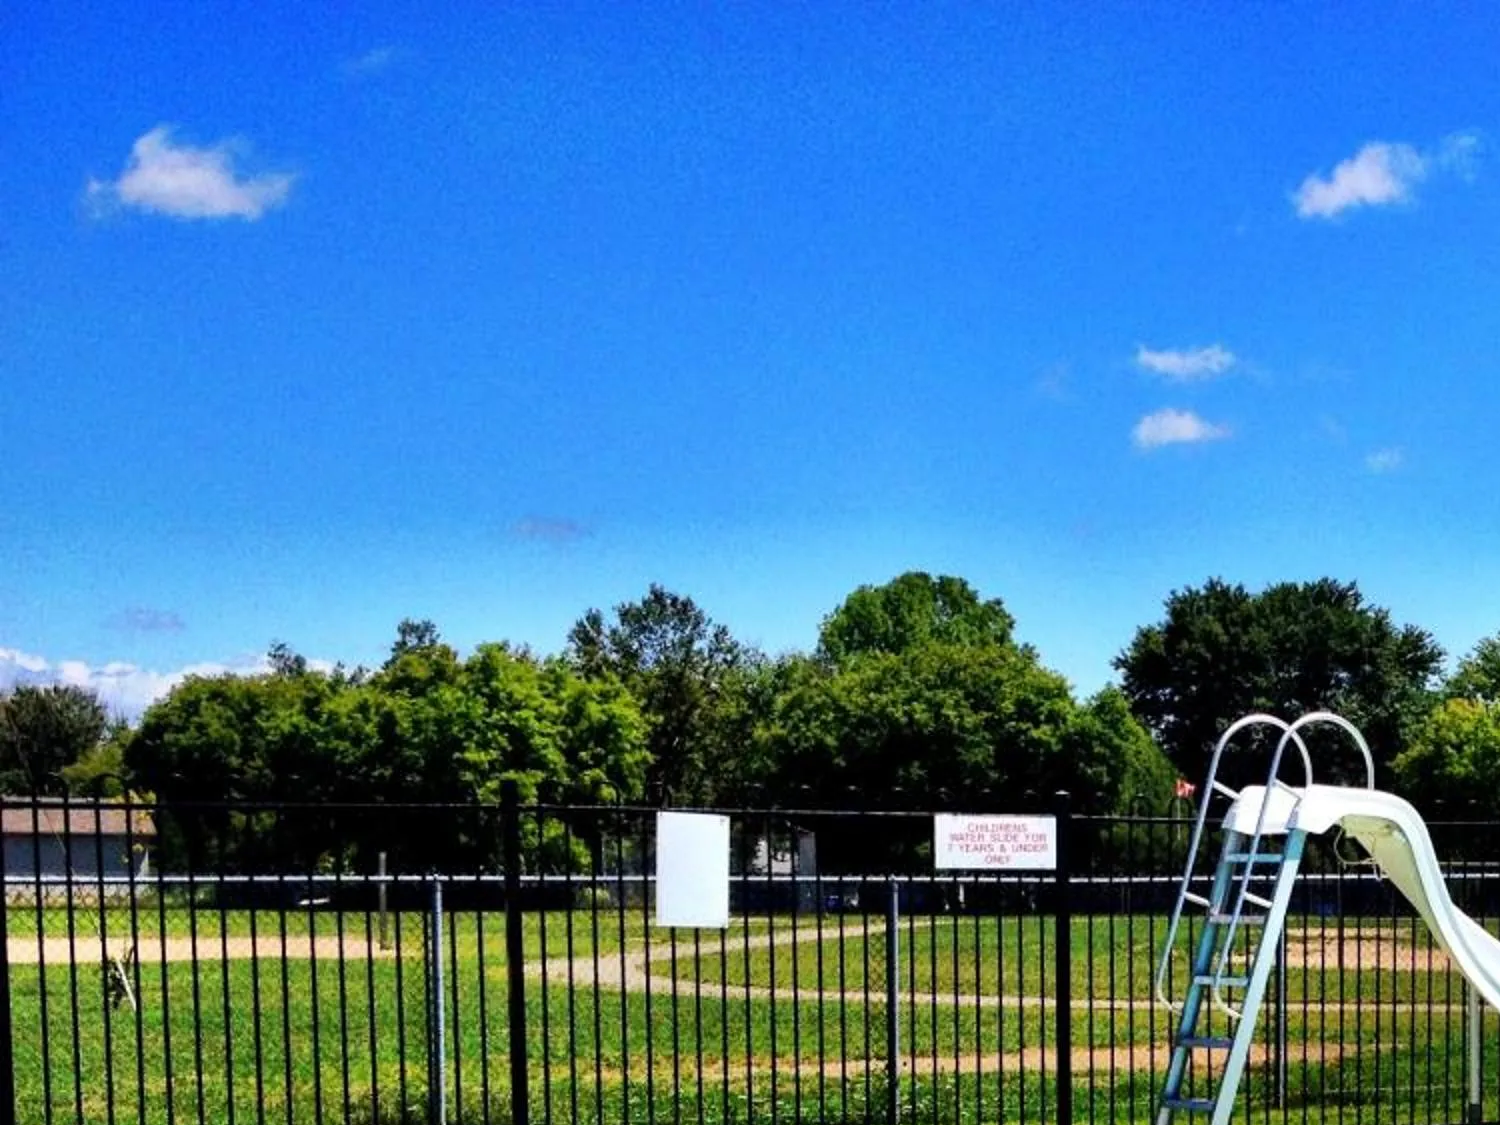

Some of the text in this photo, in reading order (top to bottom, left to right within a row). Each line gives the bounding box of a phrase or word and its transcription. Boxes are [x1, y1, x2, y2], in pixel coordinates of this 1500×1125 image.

[949, 833, 985, 843] WATER
[991, 833, 1018, 843] SLIDE
[959, 843, 995, 853] YEARS
[1000, 844, 1007, 853] &
[1012, 844, 1048, 853] UNDER
[984, 855, 1011, 865] ONLY
